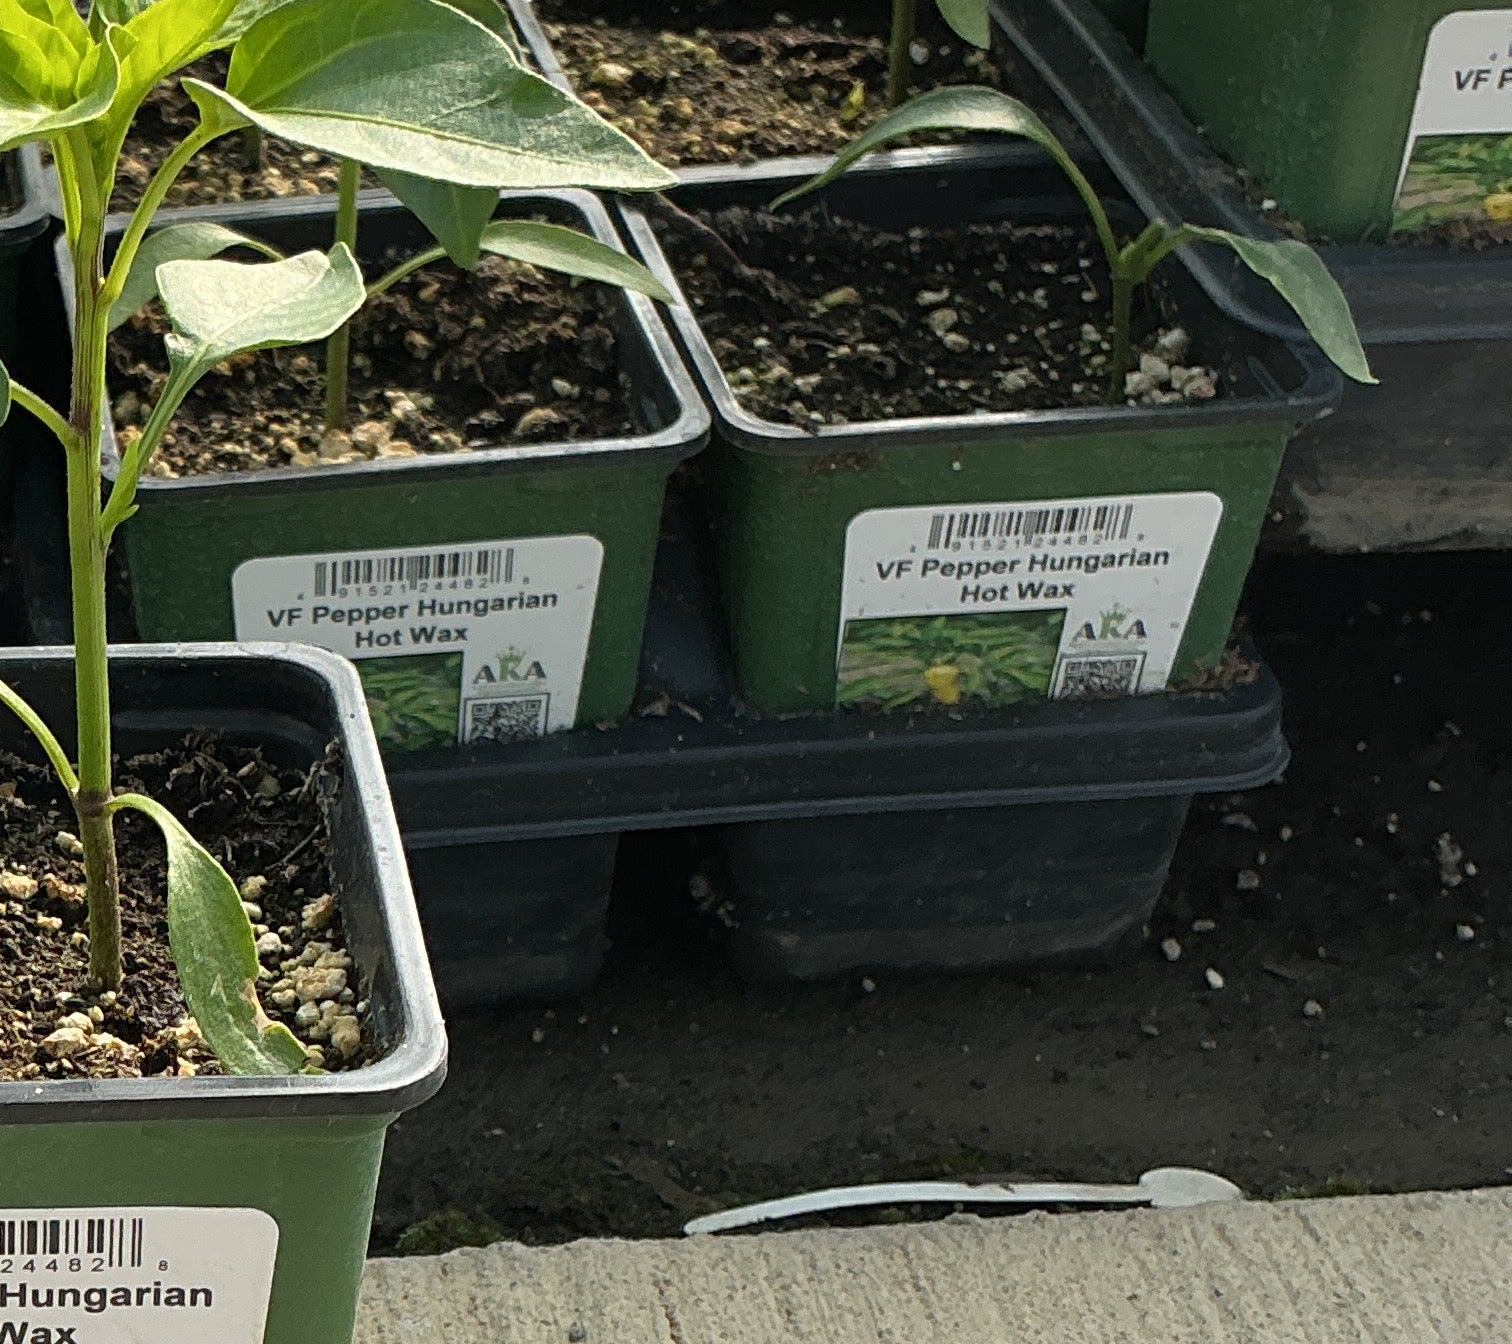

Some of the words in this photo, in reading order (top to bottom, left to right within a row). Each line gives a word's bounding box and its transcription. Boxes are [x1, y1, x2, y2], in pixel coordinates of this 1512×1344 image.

[1455, 68, 1492, 91] VF
[876, 559, 913, 581] VF
[921, 558, 1021, 580] Pepper
[1028, 547, 1170, 574] Hungarian
[960, 582, 1009, 604] Hot
[1017, 580, 1075, 600] Wax
[266, 607, 303, 628] VF
[312, 604, 410, 626] Pepper
[417, 591, 558, 617] Hungarian
[355, 629, 403, 649] Hot
[409, 625, 468, 644] Wax
[472, 660, 547, 684] AKA
[0, 1280, 213, 1313] Hungarian
